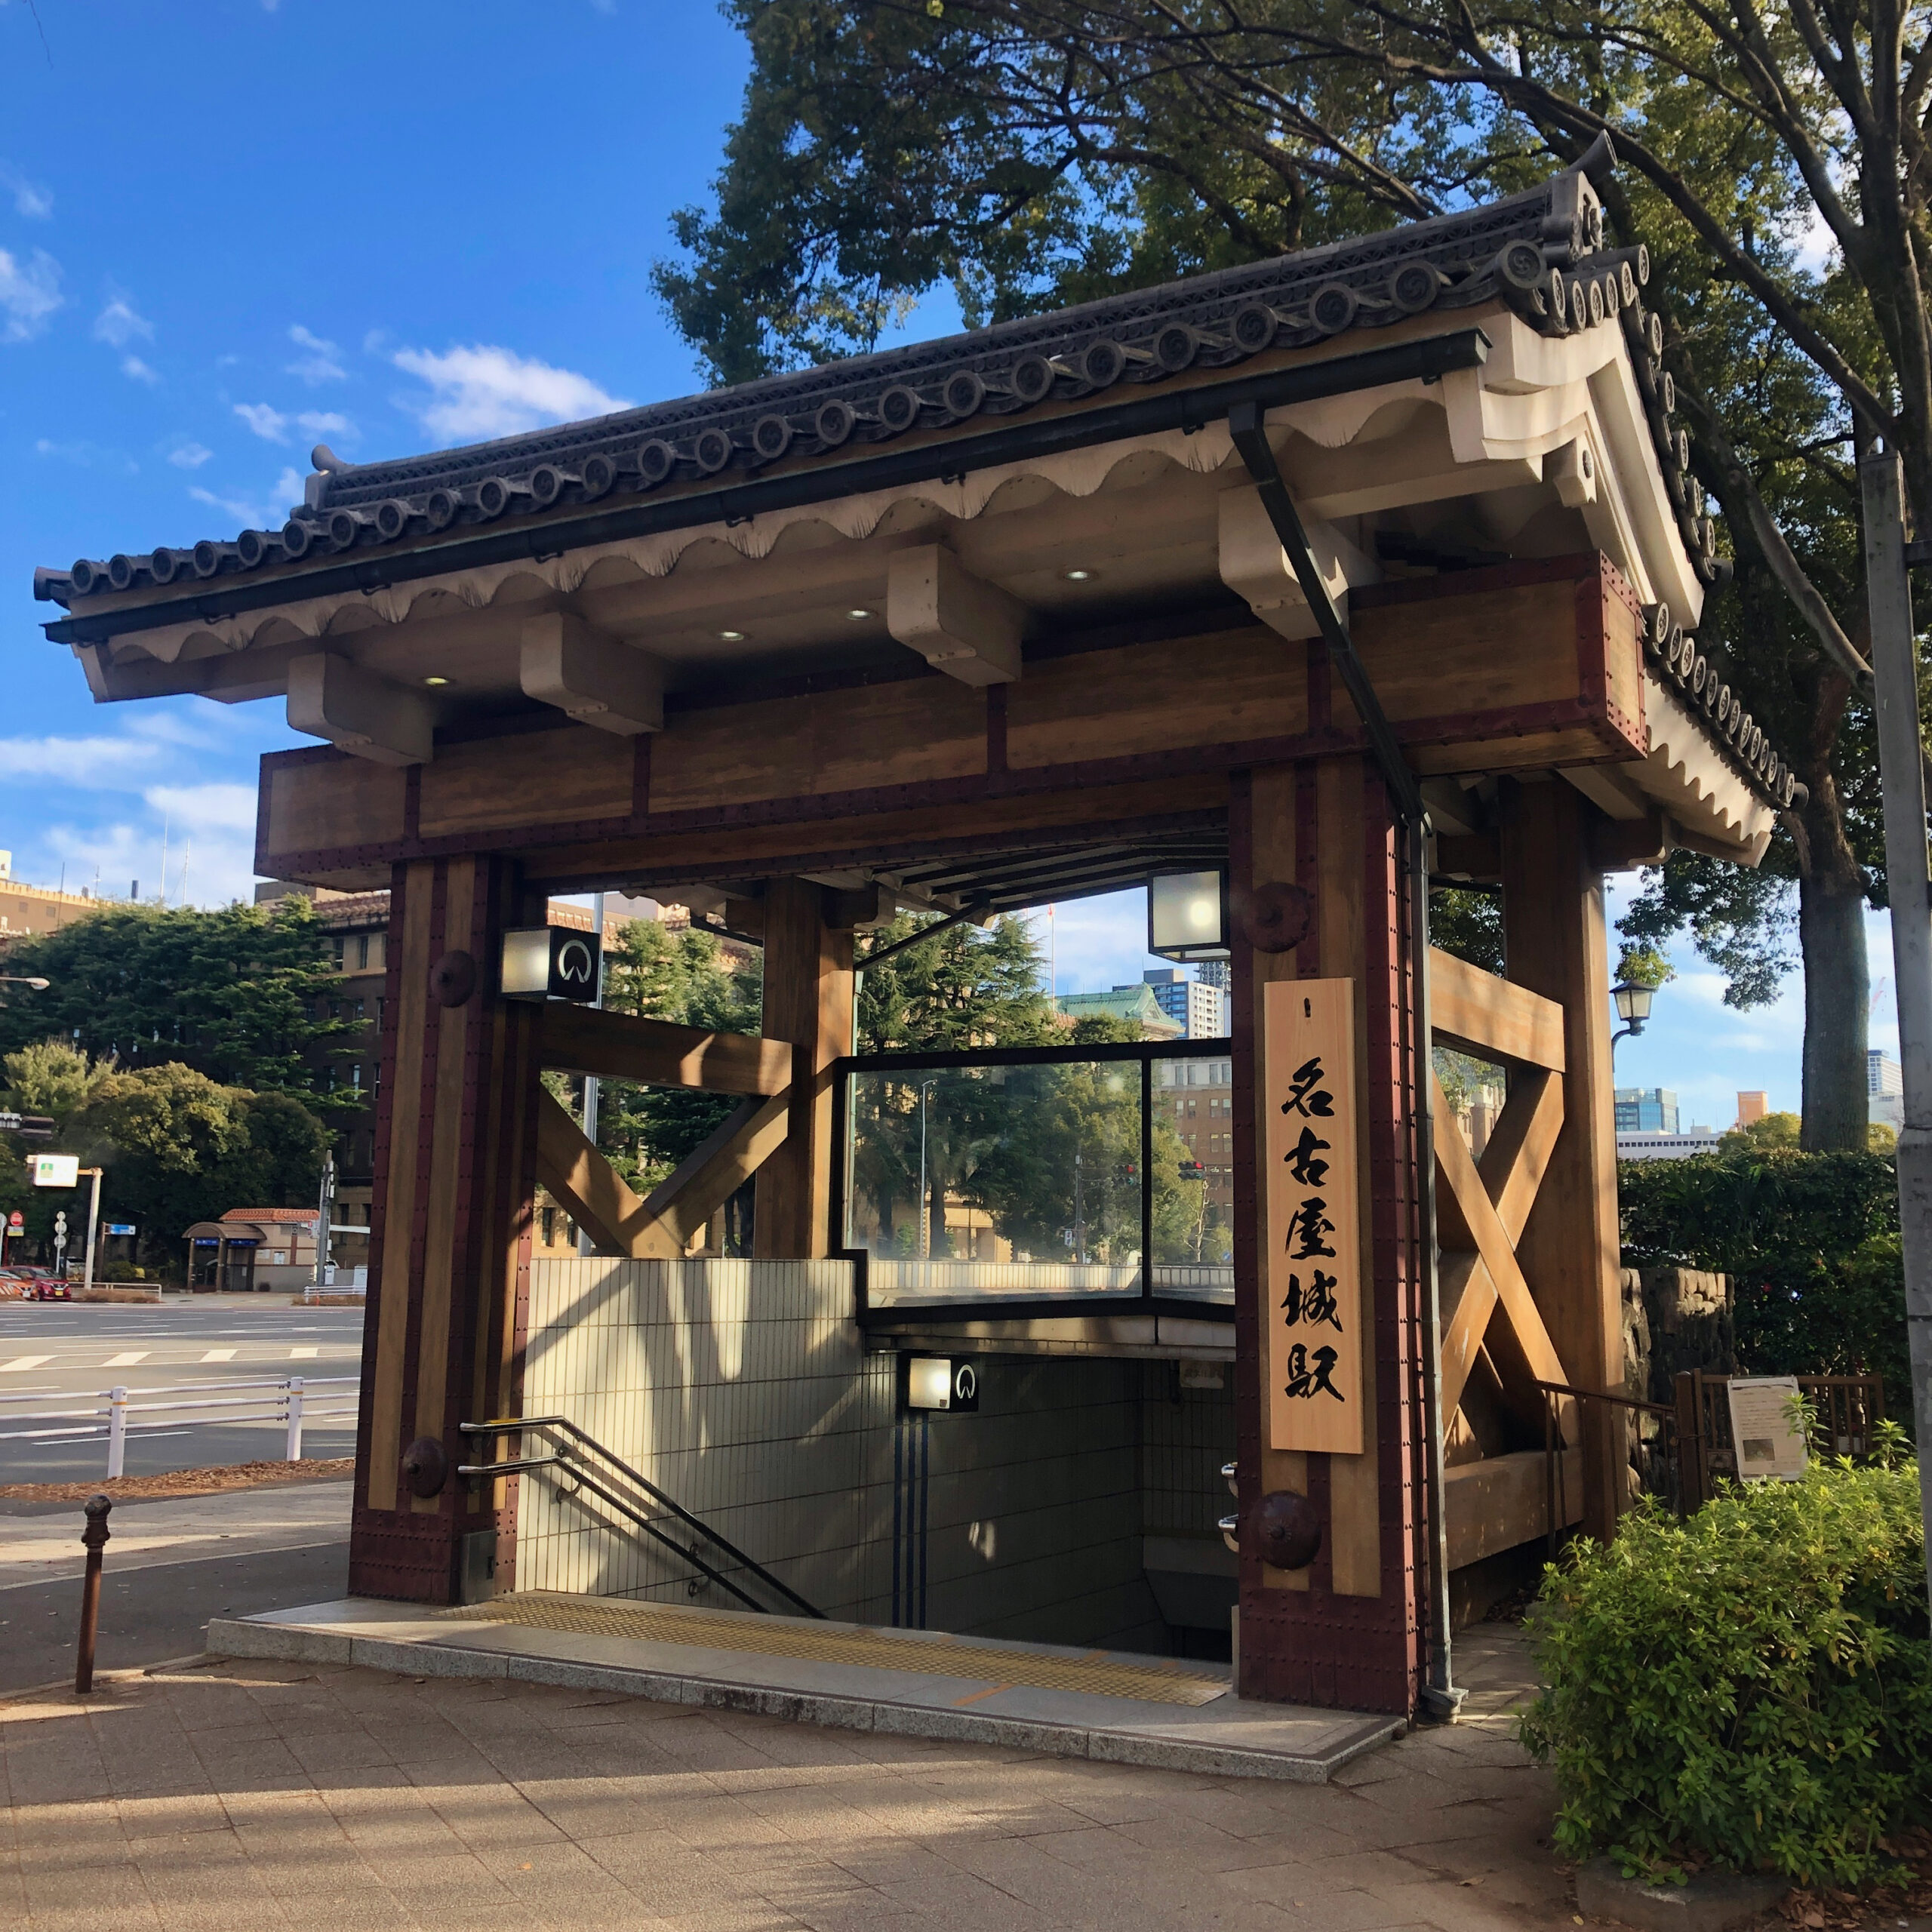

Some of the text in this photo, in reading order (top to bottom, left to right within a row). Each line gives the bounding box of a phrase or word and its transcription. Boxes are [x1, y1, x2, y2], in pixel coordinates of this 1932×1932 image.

[1280, 1057, 1345, 1402] 名古屋城駅
